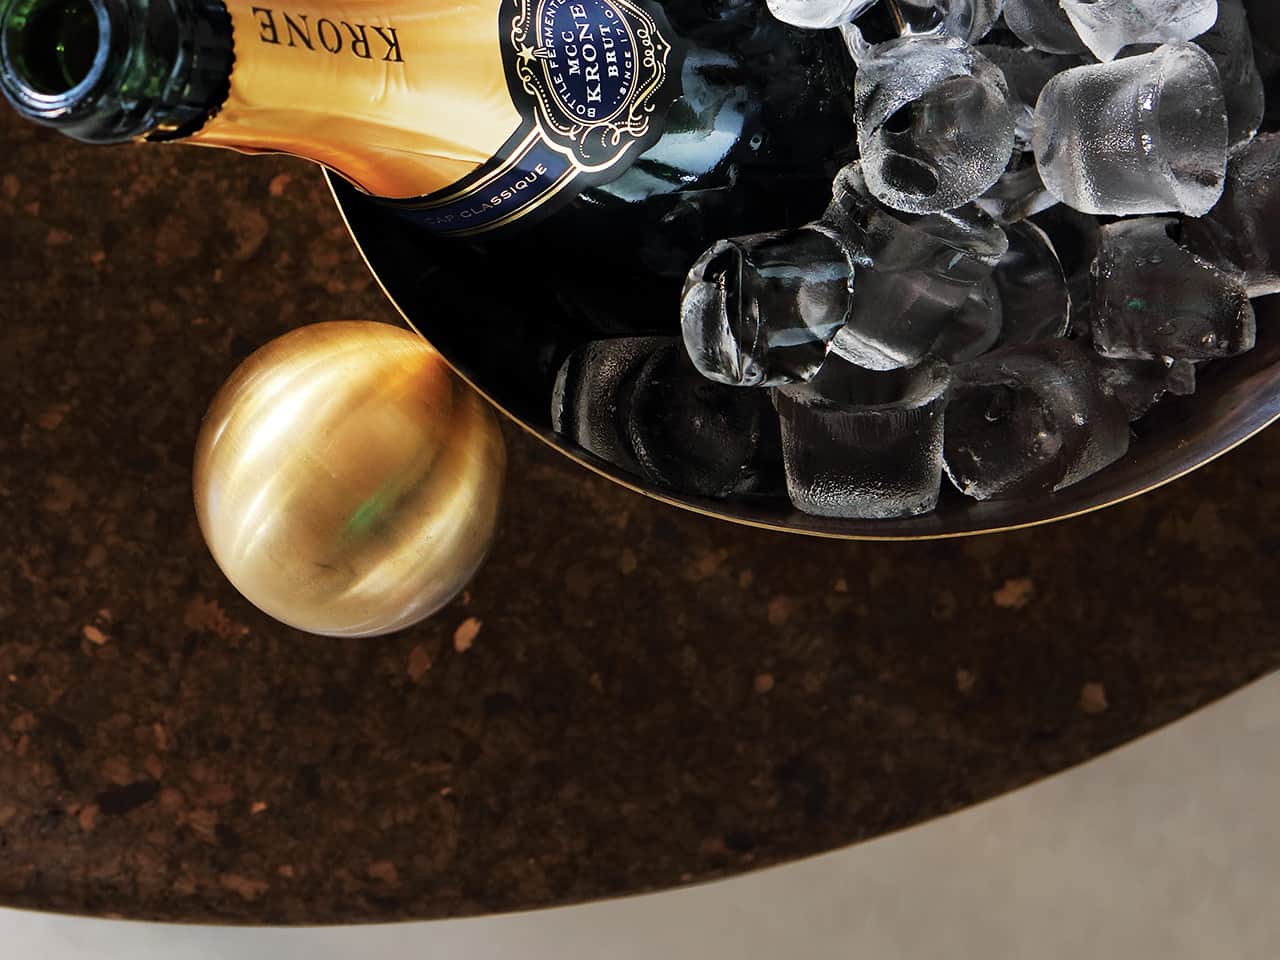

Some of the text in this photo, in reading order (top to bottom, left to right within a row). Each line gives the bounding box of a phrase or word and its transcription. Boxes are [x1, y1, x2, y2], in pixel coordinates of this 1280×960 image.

[251, 6, 405, 63] KRONE
[561, 30, 581, 75] MCC
[570, 3, 602, 103] KRONE
[599, 24, 619, 78] BRUT
[553, 73, 596, 118] BOTTLE
[619, 50, 632, 96] SINCE
[459, 163, 548, 219] CLASSIQUE
